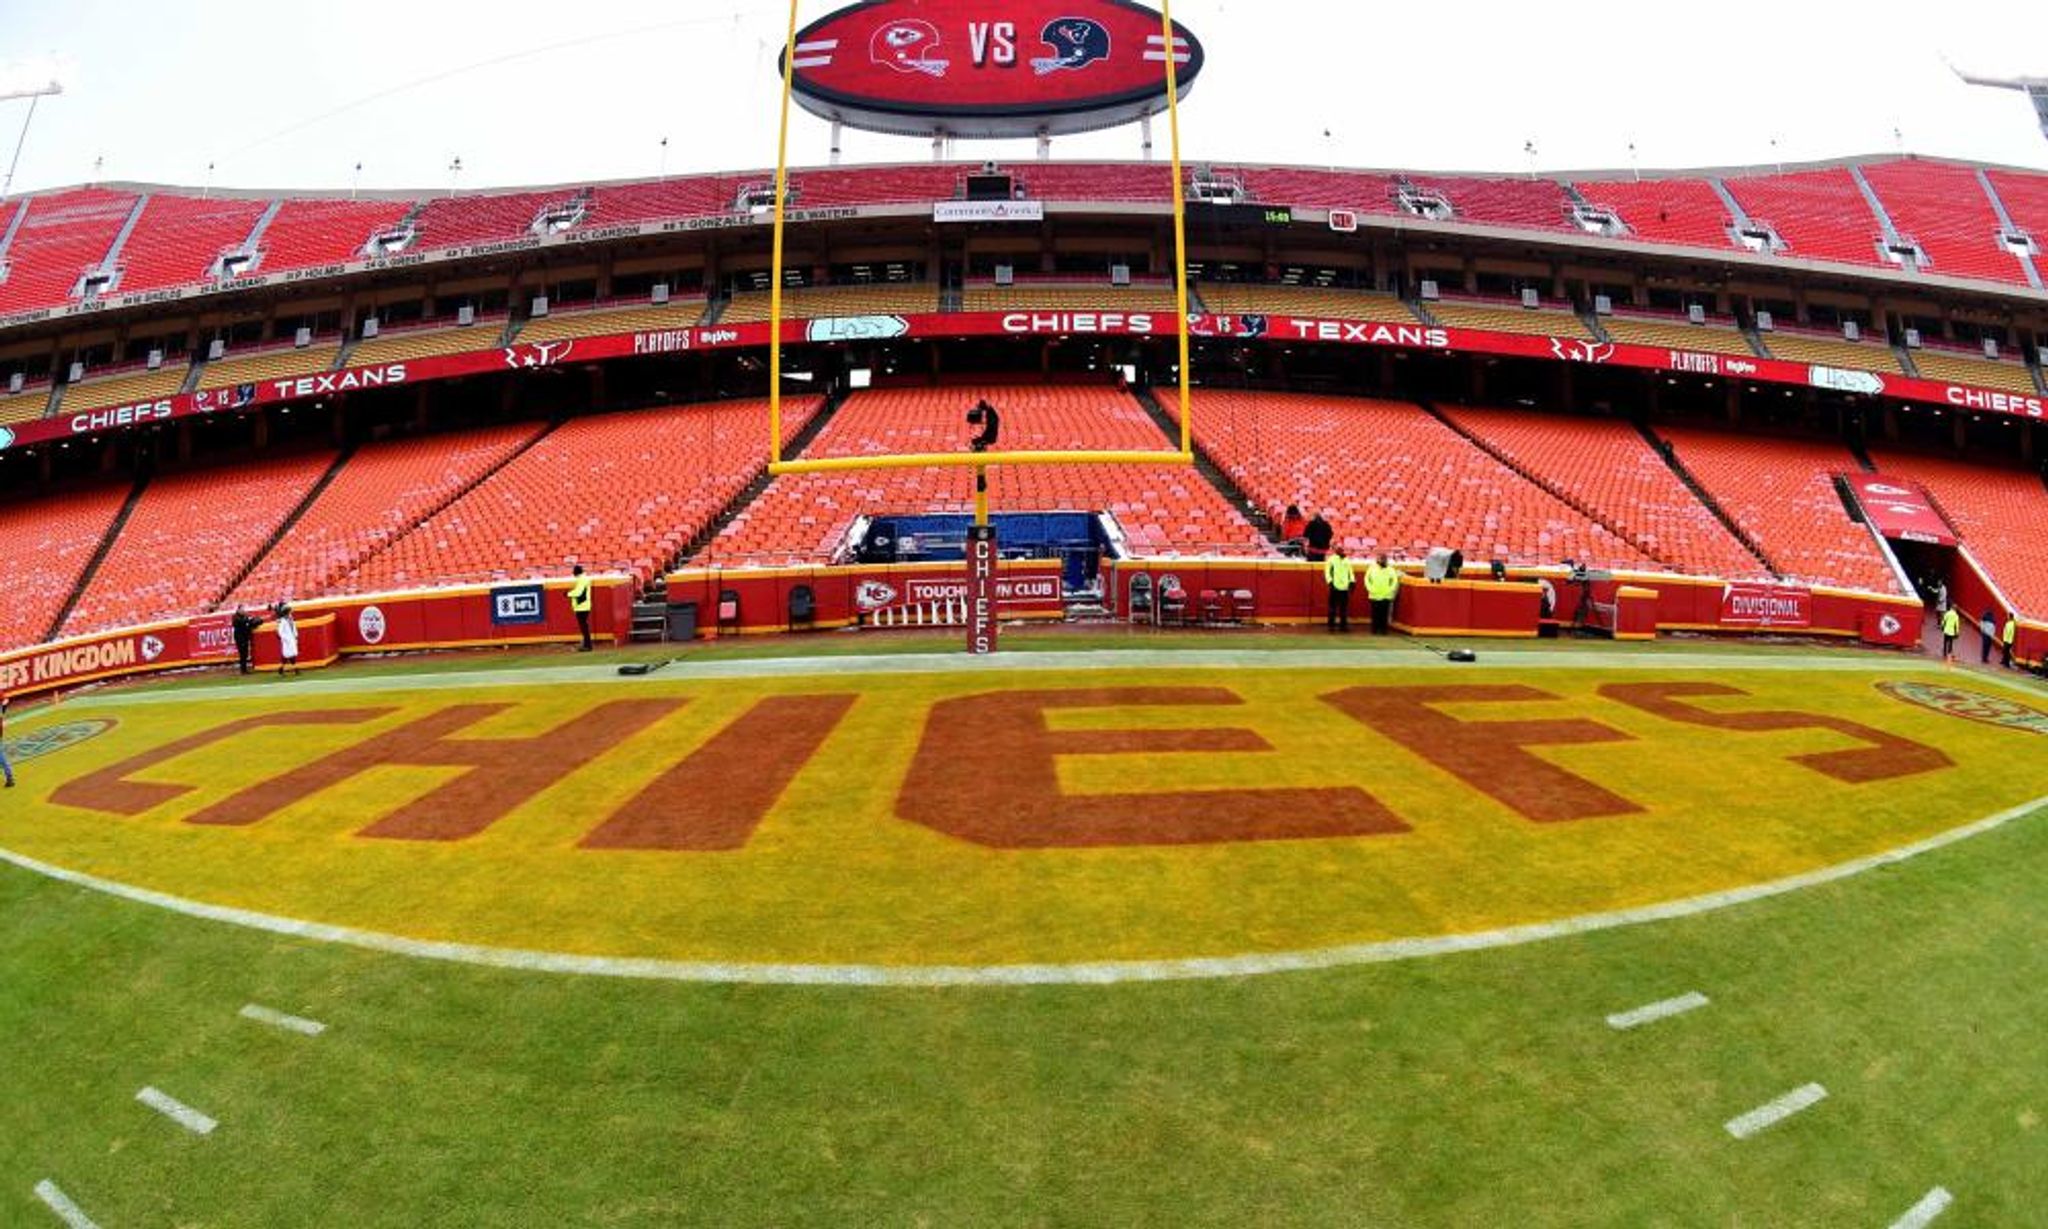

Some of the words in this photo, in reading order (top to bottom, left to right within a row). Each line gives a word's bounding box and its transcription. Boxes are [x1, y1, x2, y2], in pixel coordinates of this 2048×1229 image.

[968, 22, 1015, 65] VS
[1002, 313, 1152, 332] CHIEFS
[1290, 319, 1450, 347] TEXANS
[634, 329, 690, 354] PLAYOFFS
[1669, 350, 1718, 374] PLAYOFFS
[274, 365, 406, 398] TEXANS
[71, 400, 172, 432] CHIEFS
[1946, 386, 2043, 417] CHIEFS
[976, 541, 989, 653] CHIEFS
[1014, 583, 1052, 595] CLUB
[1732, 596, 1799, 617] DIVISIONAL
[33, 638, 136, 682] KINGDOM
[48, 682, 1957, 851] CHIEFS
